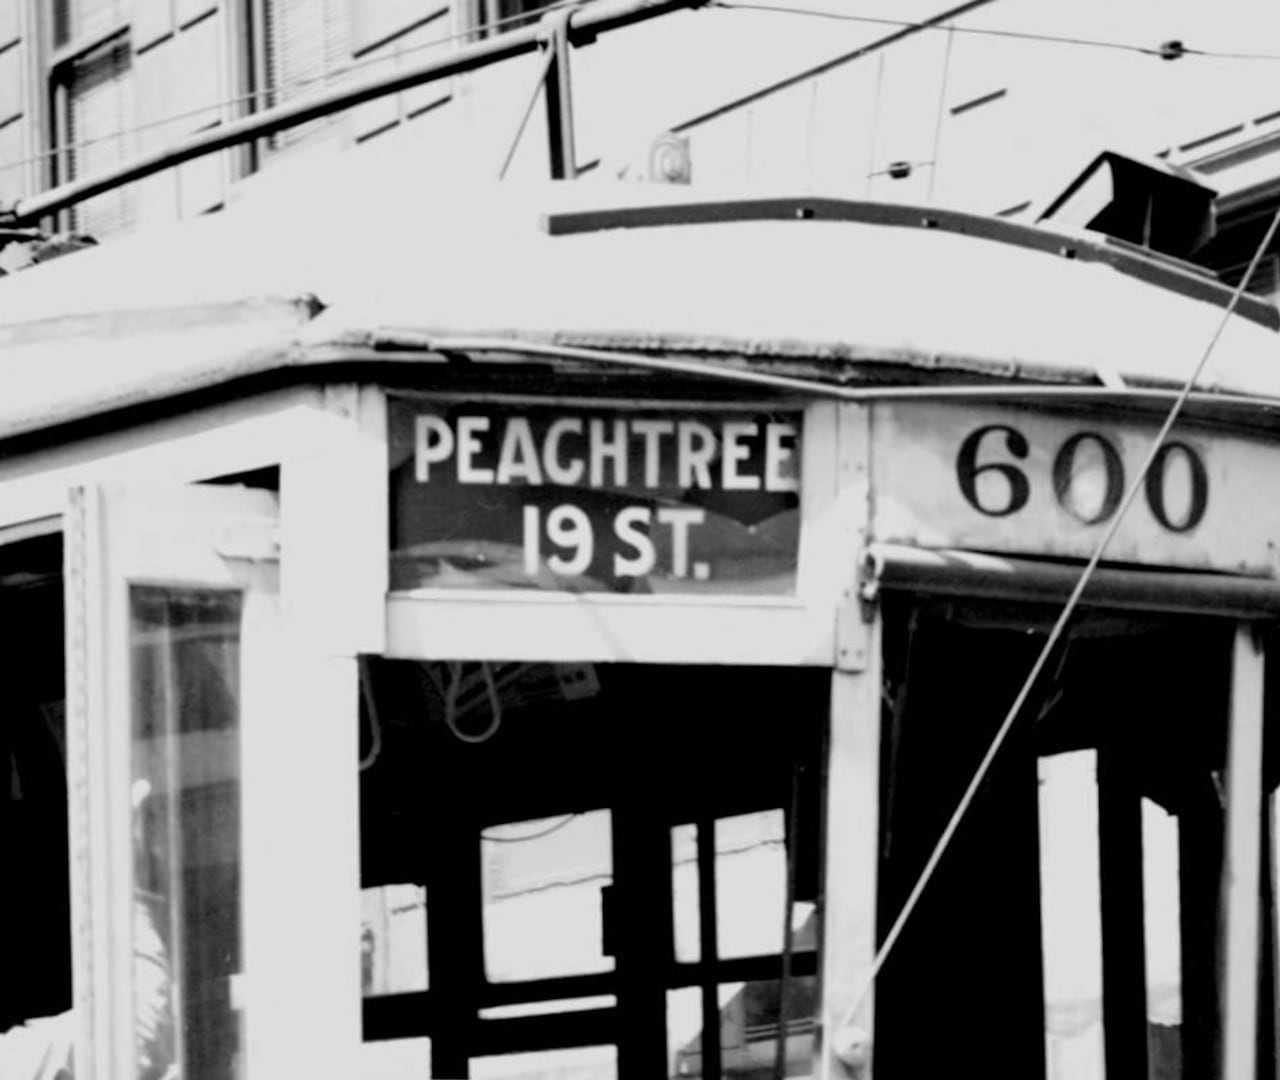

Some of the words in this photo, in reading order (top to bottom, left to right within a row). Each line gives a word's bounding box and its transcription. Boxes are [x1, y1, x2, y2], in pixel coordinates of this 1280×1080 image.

[413, 415, 798, 491] PEACHTREE
[956, 425, 1210, 534] 600
[522, 506, 594, 576] 19
[613, 507, 711, 580] ST.
